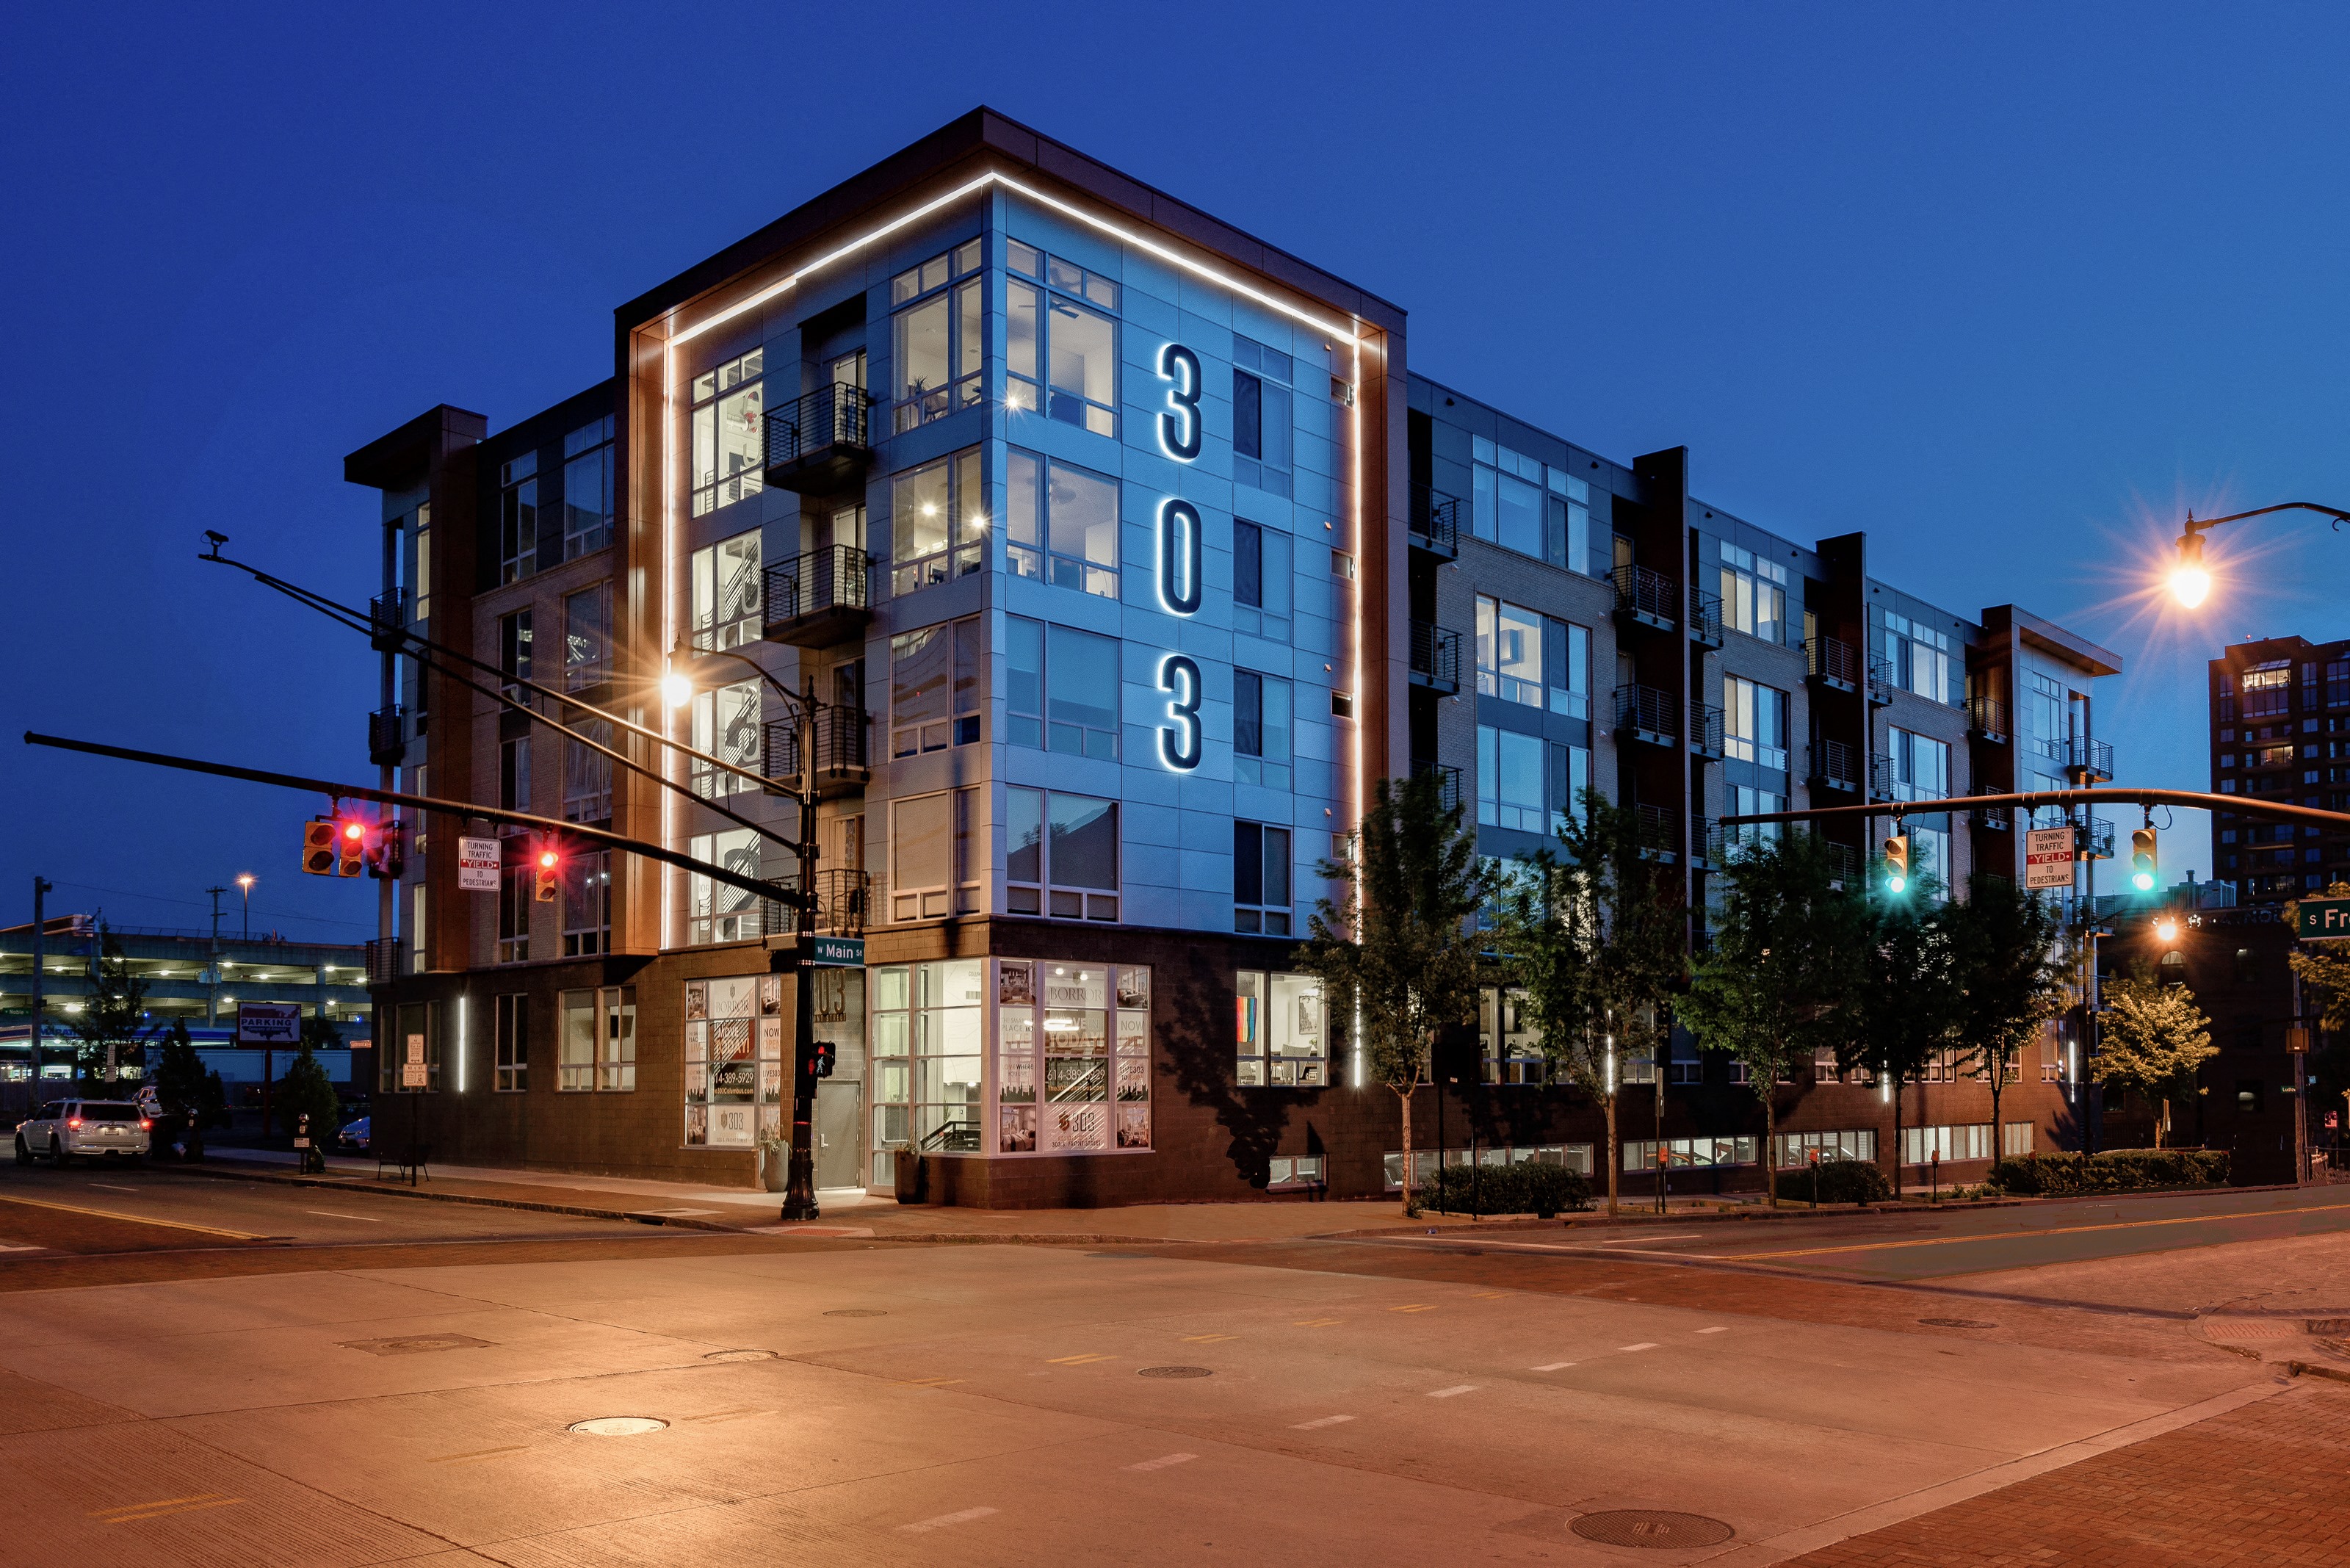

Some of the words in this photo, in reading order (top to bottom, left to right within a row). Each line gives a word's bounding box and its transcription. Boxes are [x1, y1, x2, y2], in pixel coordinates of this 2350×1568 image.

[2035, 831, 2064, 842] TURNING
[468, 842, 493, 850] TURNING
[2036, 842, 2064, 851] TRAFFIC
[2034, 853, 2066, 864] YIELD
[466, 860, 494, 869] YIELD
[2046, 865, 2053, 873] TO
[463, 878, 496, 887] PEDESTRIANS
[2030, 874, 2069, 884] PEDESTRIANS
[2310, 914, 2317, 925] S
[2325, 908, 2350, 928] Fr
[826, 944, 853, 958] Main
[1050, 987, 1102, 1001] BORROR
[716, 1000, 749, 1013] BORROR
[1121, 1020, 1144, 1031] NOW
[764, 1027, 780, 1037] NOW
[1047, 1069, 1105, 1080] 614-3895929
[728, 1113, 743, 1130] 303
[1072, 1113, 1095, 1132] 303
